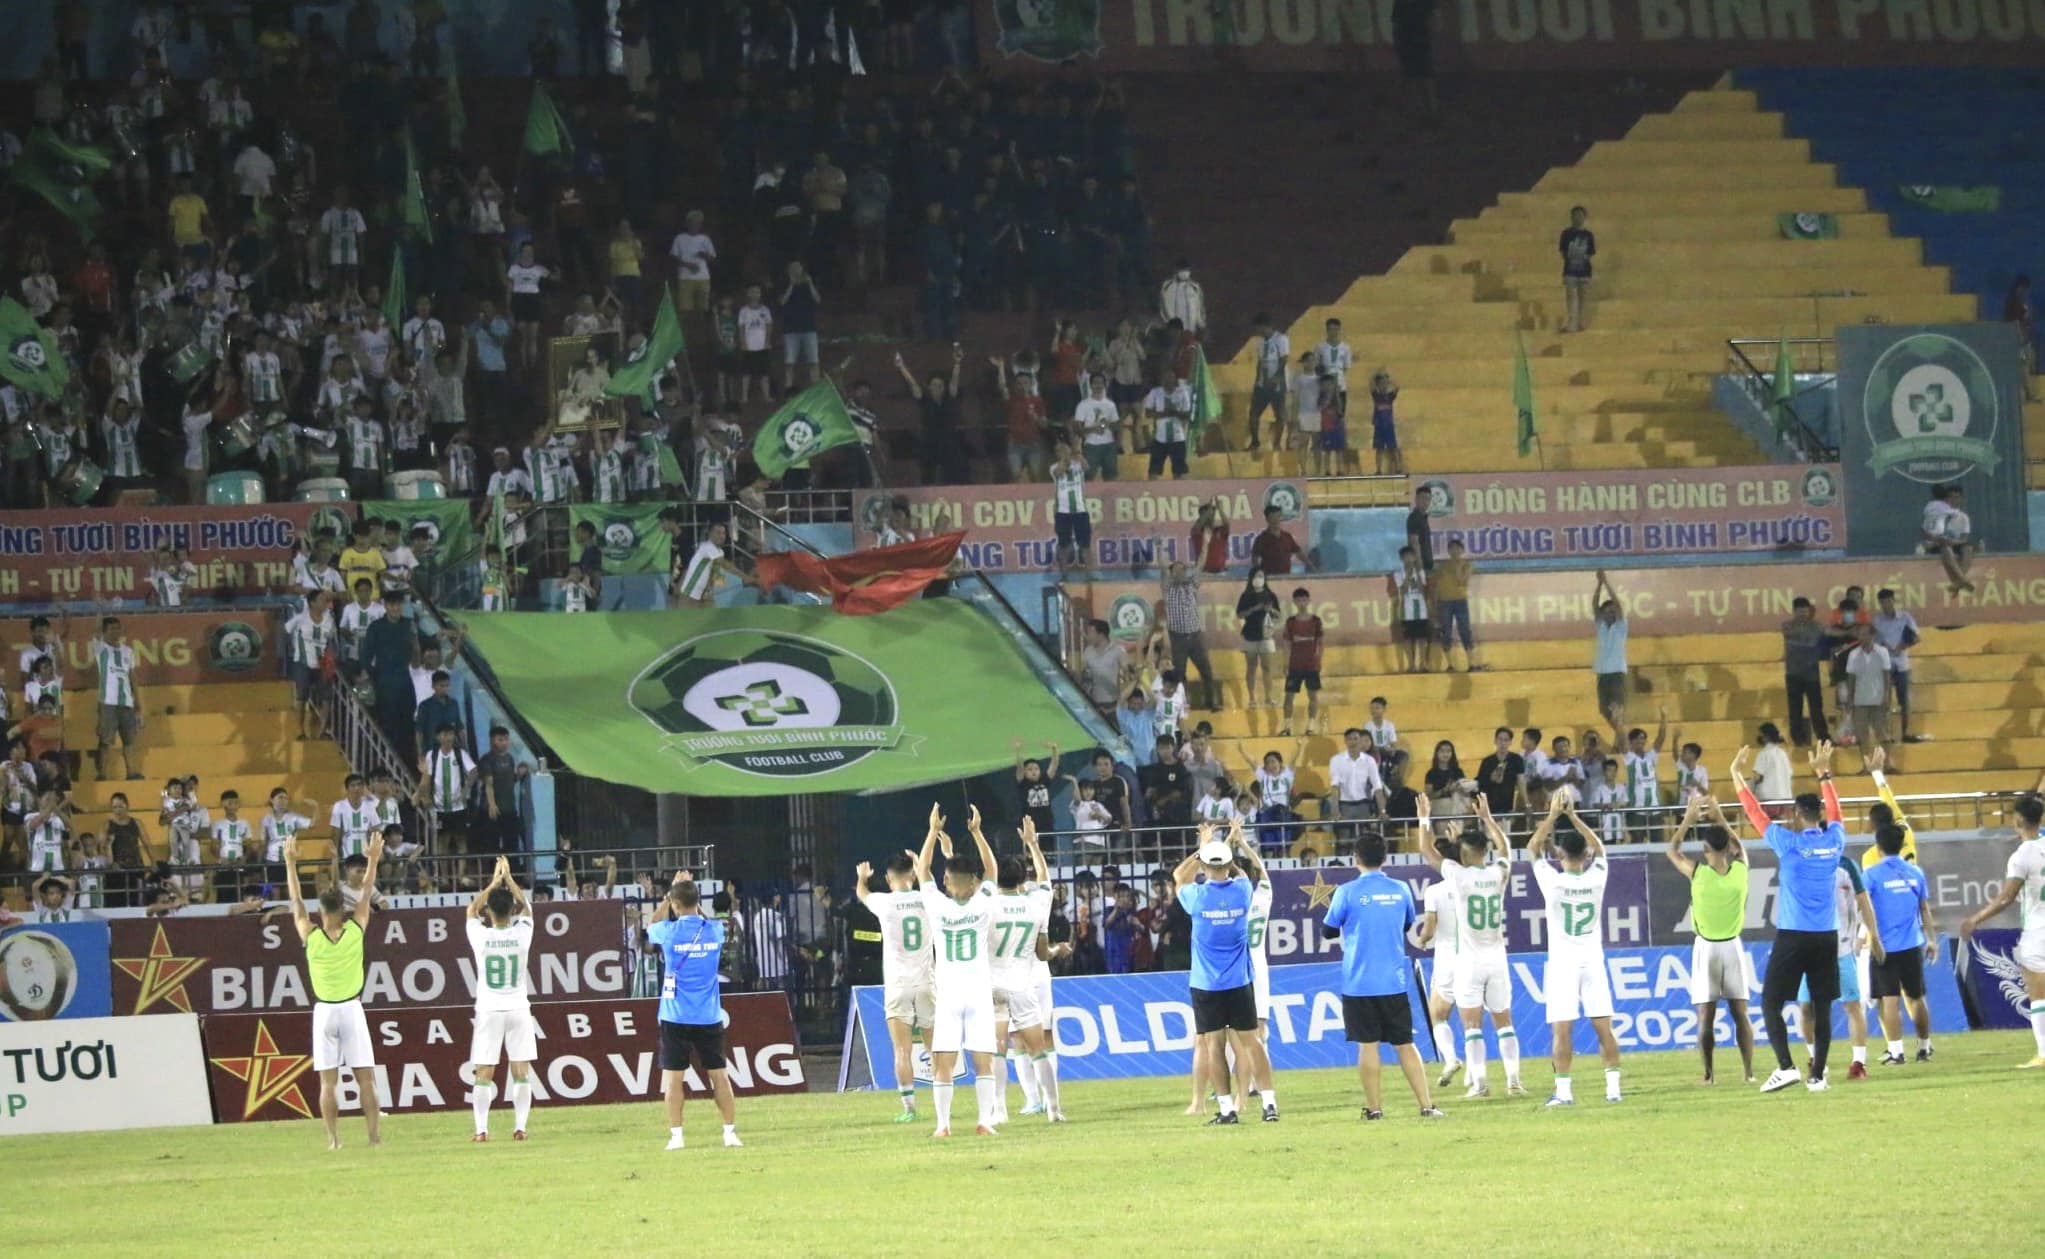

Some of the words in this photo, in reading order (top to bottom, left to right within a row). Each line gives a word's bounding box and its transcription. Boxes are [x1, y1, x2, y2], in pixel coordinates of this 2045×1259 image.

[973, 501, 1034, 528] CĐV
[1115, 491, 1200, 523] BÓNG
[1464, 481, 1547, 514] ĐỒNG
[1556, 481, 1637, 513] HÀNH
[1648, 478, 1727, 510] CÙNG
[1738, 479, 1791, 507] CLB
[0, 526, 44, 555] NG
[50, 521, 116, 555] TƯƠI
[123, 517, 193, 552] BÌNH
[200, 513, 296, 550] PHƯỚC
[1563, 522, 1634, 552] TƯƠI
[1643, 518, 1717, 550] BÌNH
[1728, 511, 1832, 547] PHƯỚC
[47, 565, 85, 598] TỰ
[90, 566, 135, 592] TIN
[170, 556, 245, 590] HIẾN
[1687, 587, 1733, 625] TỰ
[1740, 588, 1794, 617] TIN
[745, 752, 809, 768] FOOTBALL
[812, 750, 845, 764] CLUB
[902, 916, 922, 952] 8
[1560, 901, 1595, 936] 12
[943, 928, 977, 962] 10
[995, 921, 1034, 958] 77
[211, 964, 310, 1010] BIA
[360, 959, 446, 1003] AO
[485, 954, 518, 990] 81
[1053, 1000, 1197, 1057] OLD
[3, 1039, 118, 1084] TƯƠI
[336, 1062, 447, 1112] BIA
[459, 1054, 599, 1104] SAO
[0, 1093, 28, 1118] P
